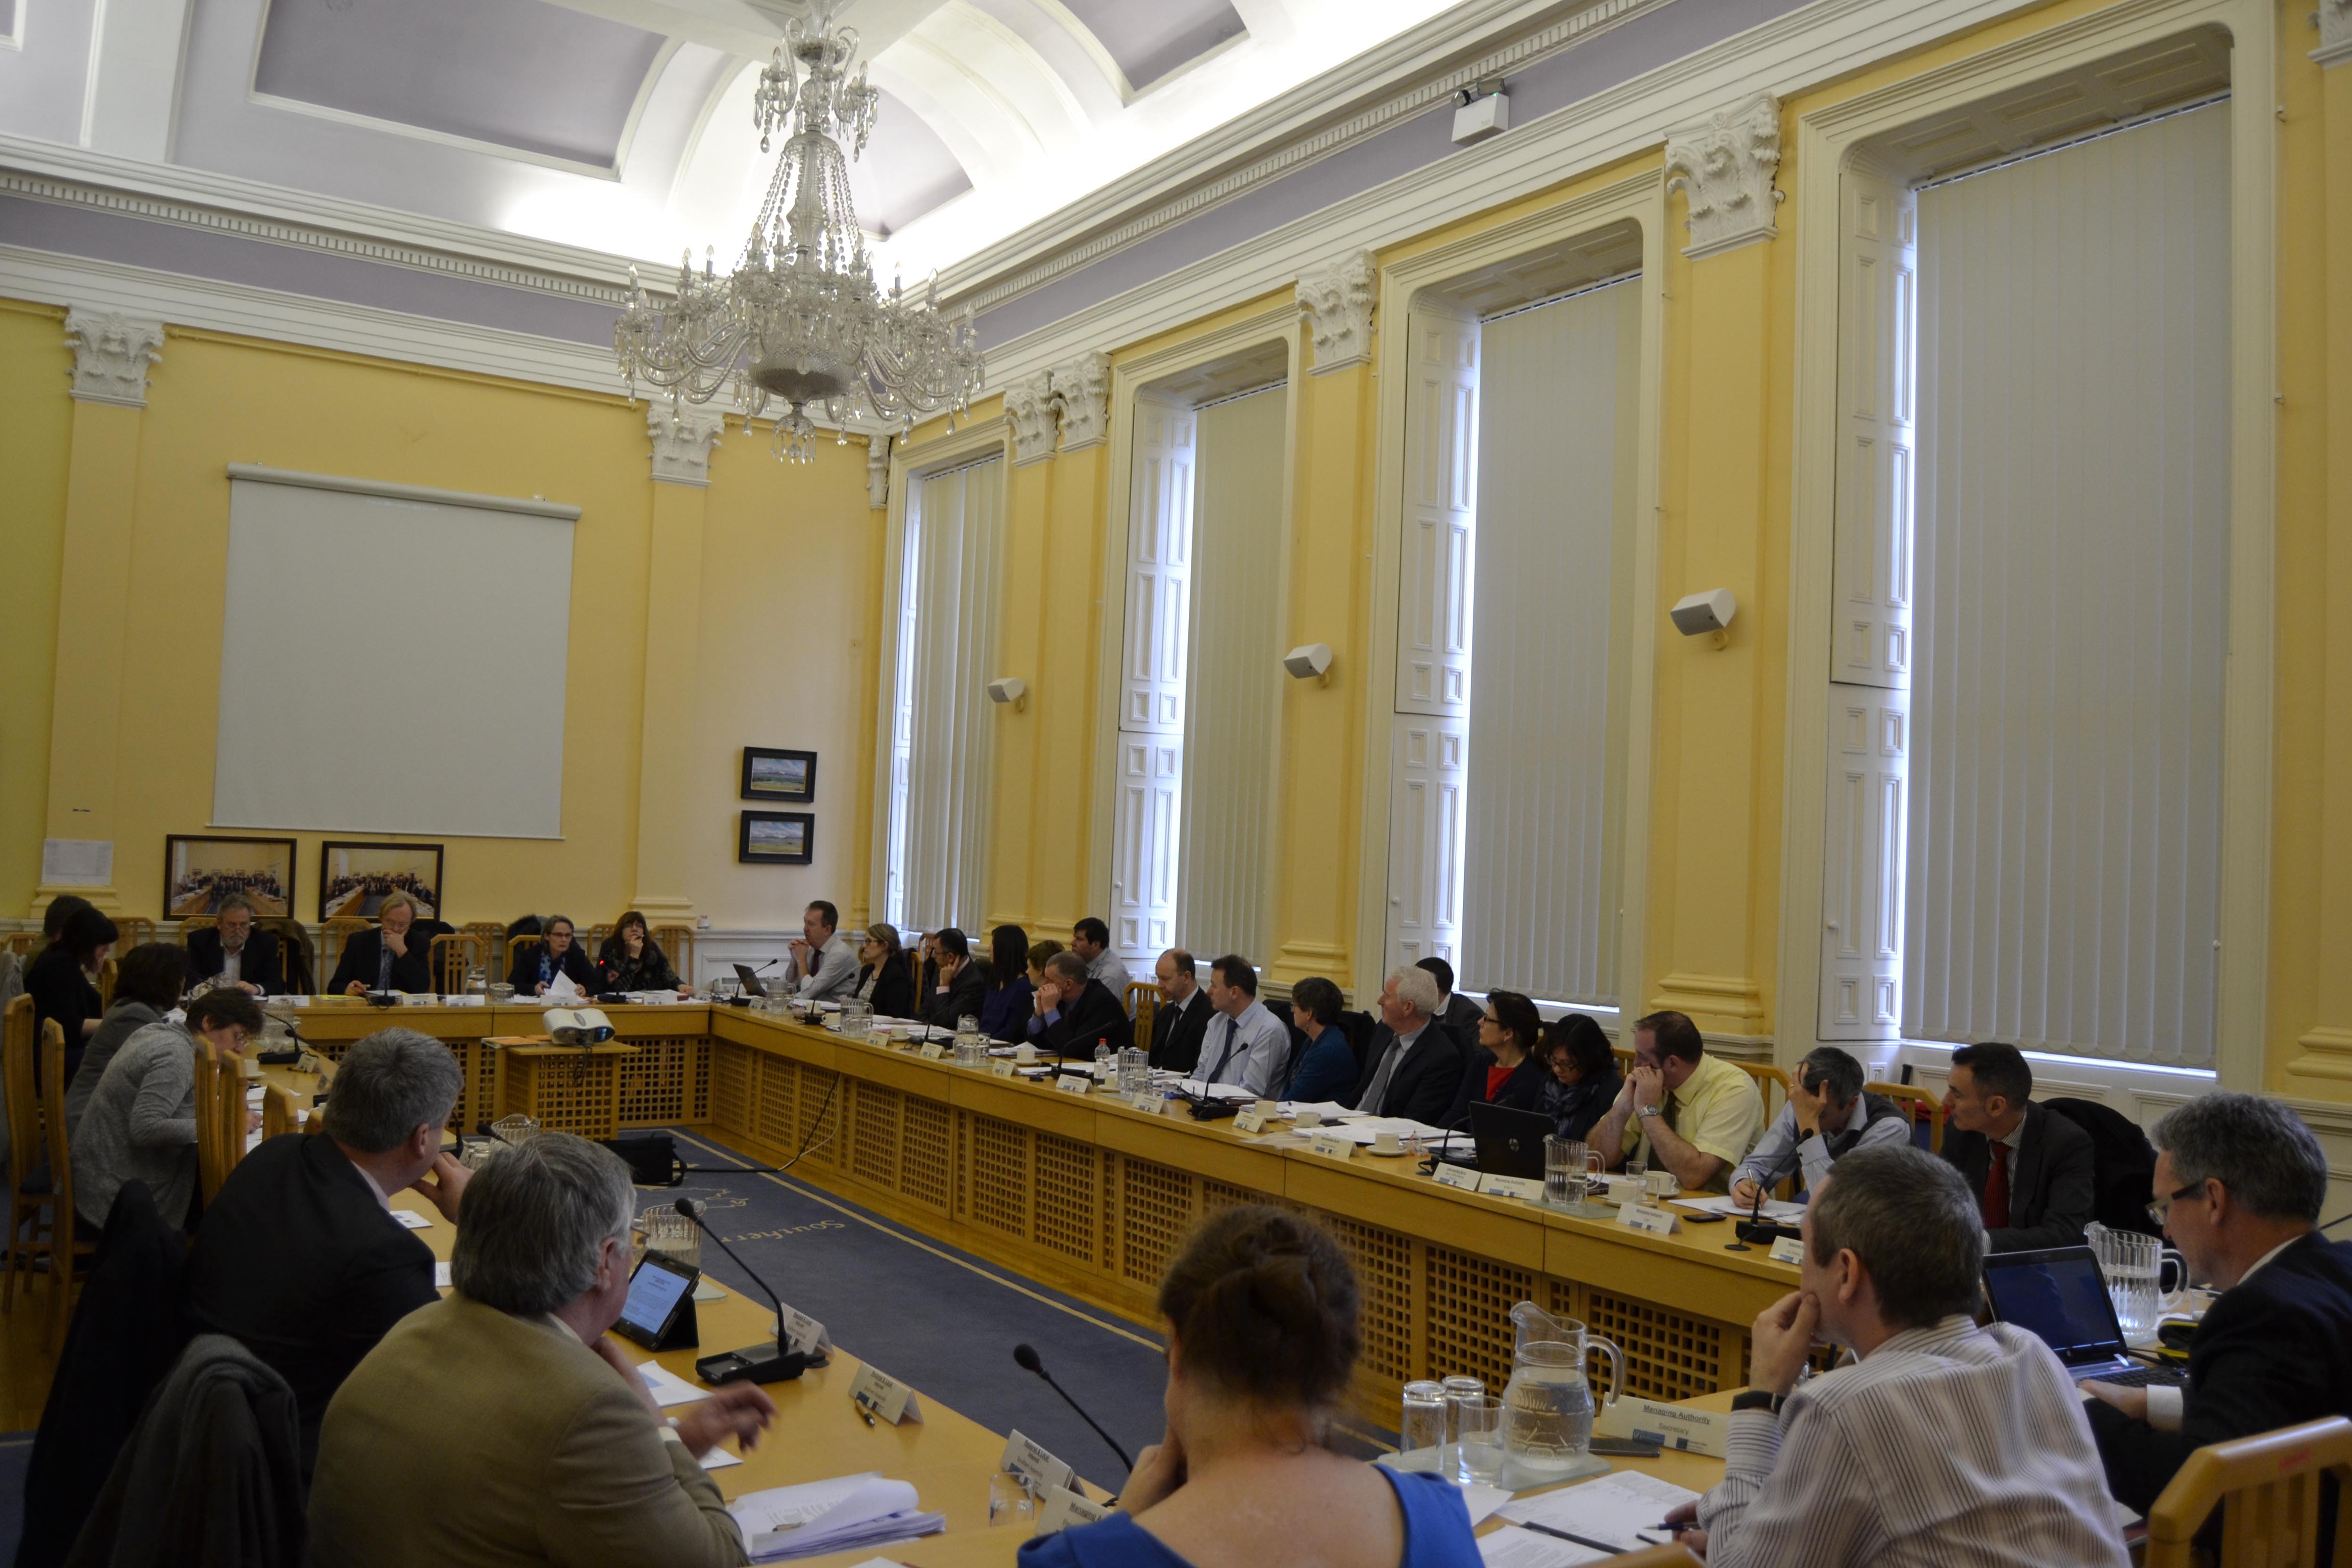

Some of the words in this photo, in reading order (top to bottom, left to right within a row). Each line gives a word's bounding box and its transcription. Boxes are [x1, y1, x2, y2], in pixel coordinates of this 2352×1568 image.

[1643, 1404, 1676, 1418] Managing
[1678, 1411, 1710, 1425] Authority
[1658, 1423, 1689, 1435] Secretary
[1069, 1501, 1096, 1522] Managing
